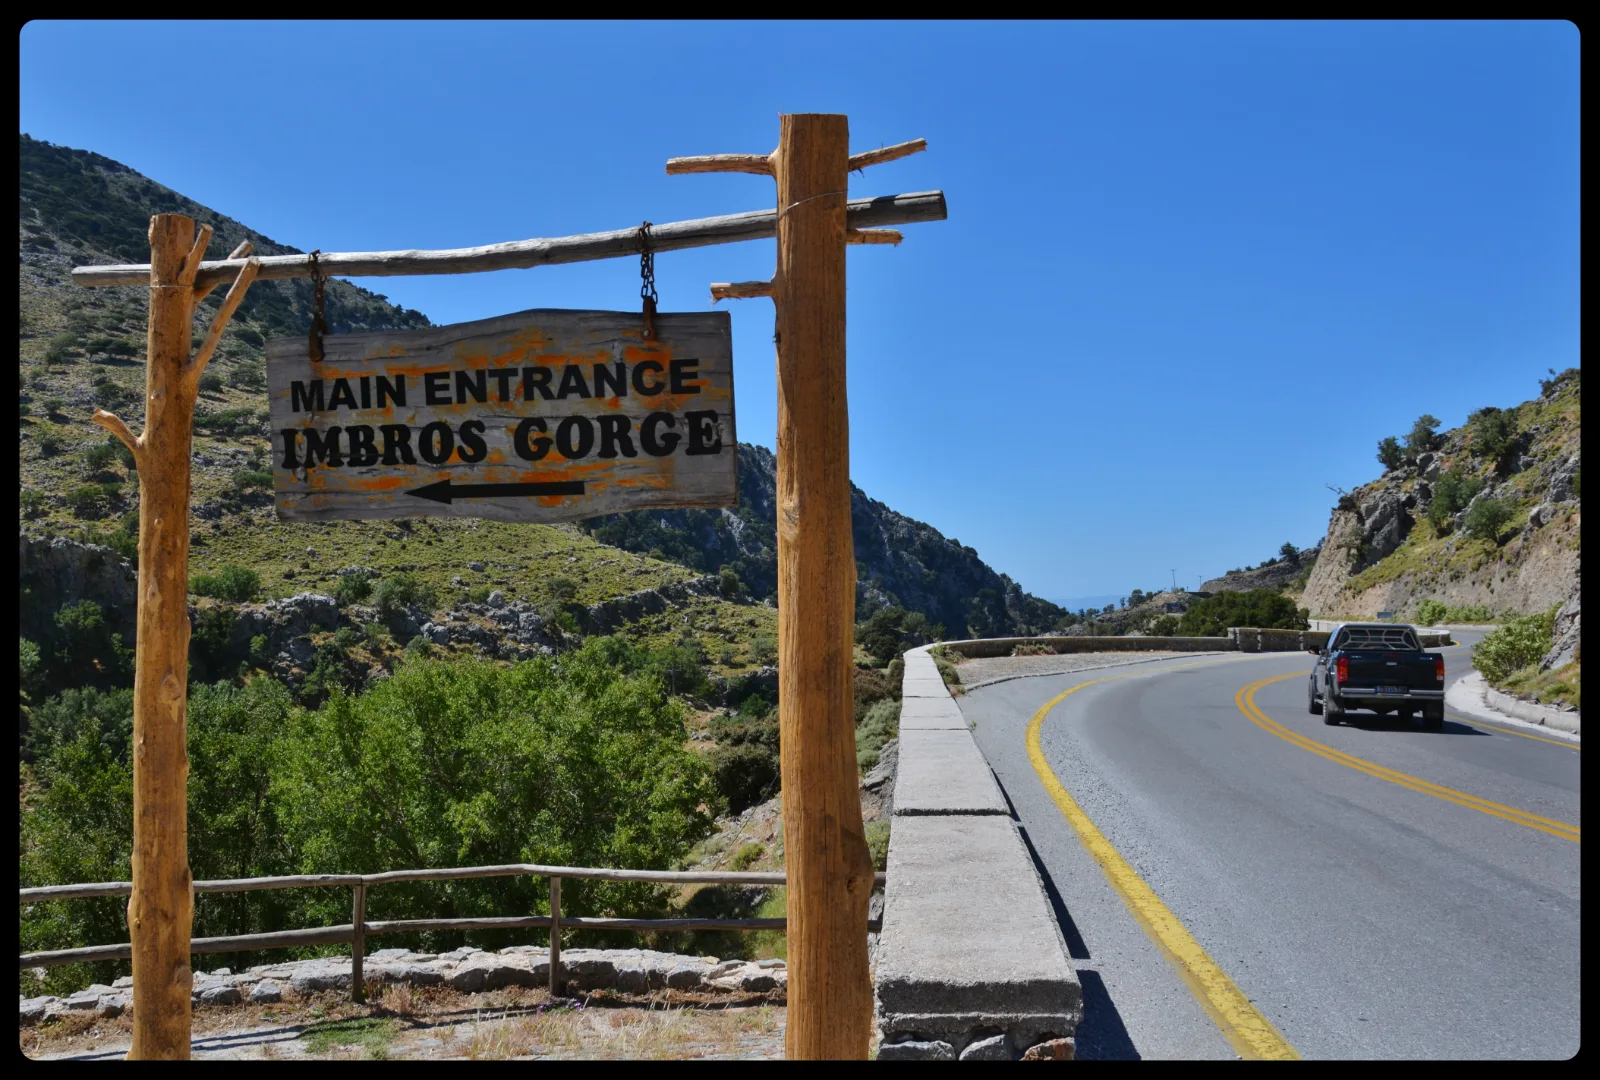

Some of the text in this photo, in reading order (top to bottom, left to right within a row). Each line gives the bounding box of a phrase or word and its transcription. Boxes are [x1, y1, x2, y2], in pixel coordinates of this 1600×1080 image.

[291, 358, 701, 413] MAIN ENTRANCE
[281, 409, 723, 470] IMBROS GORGE
